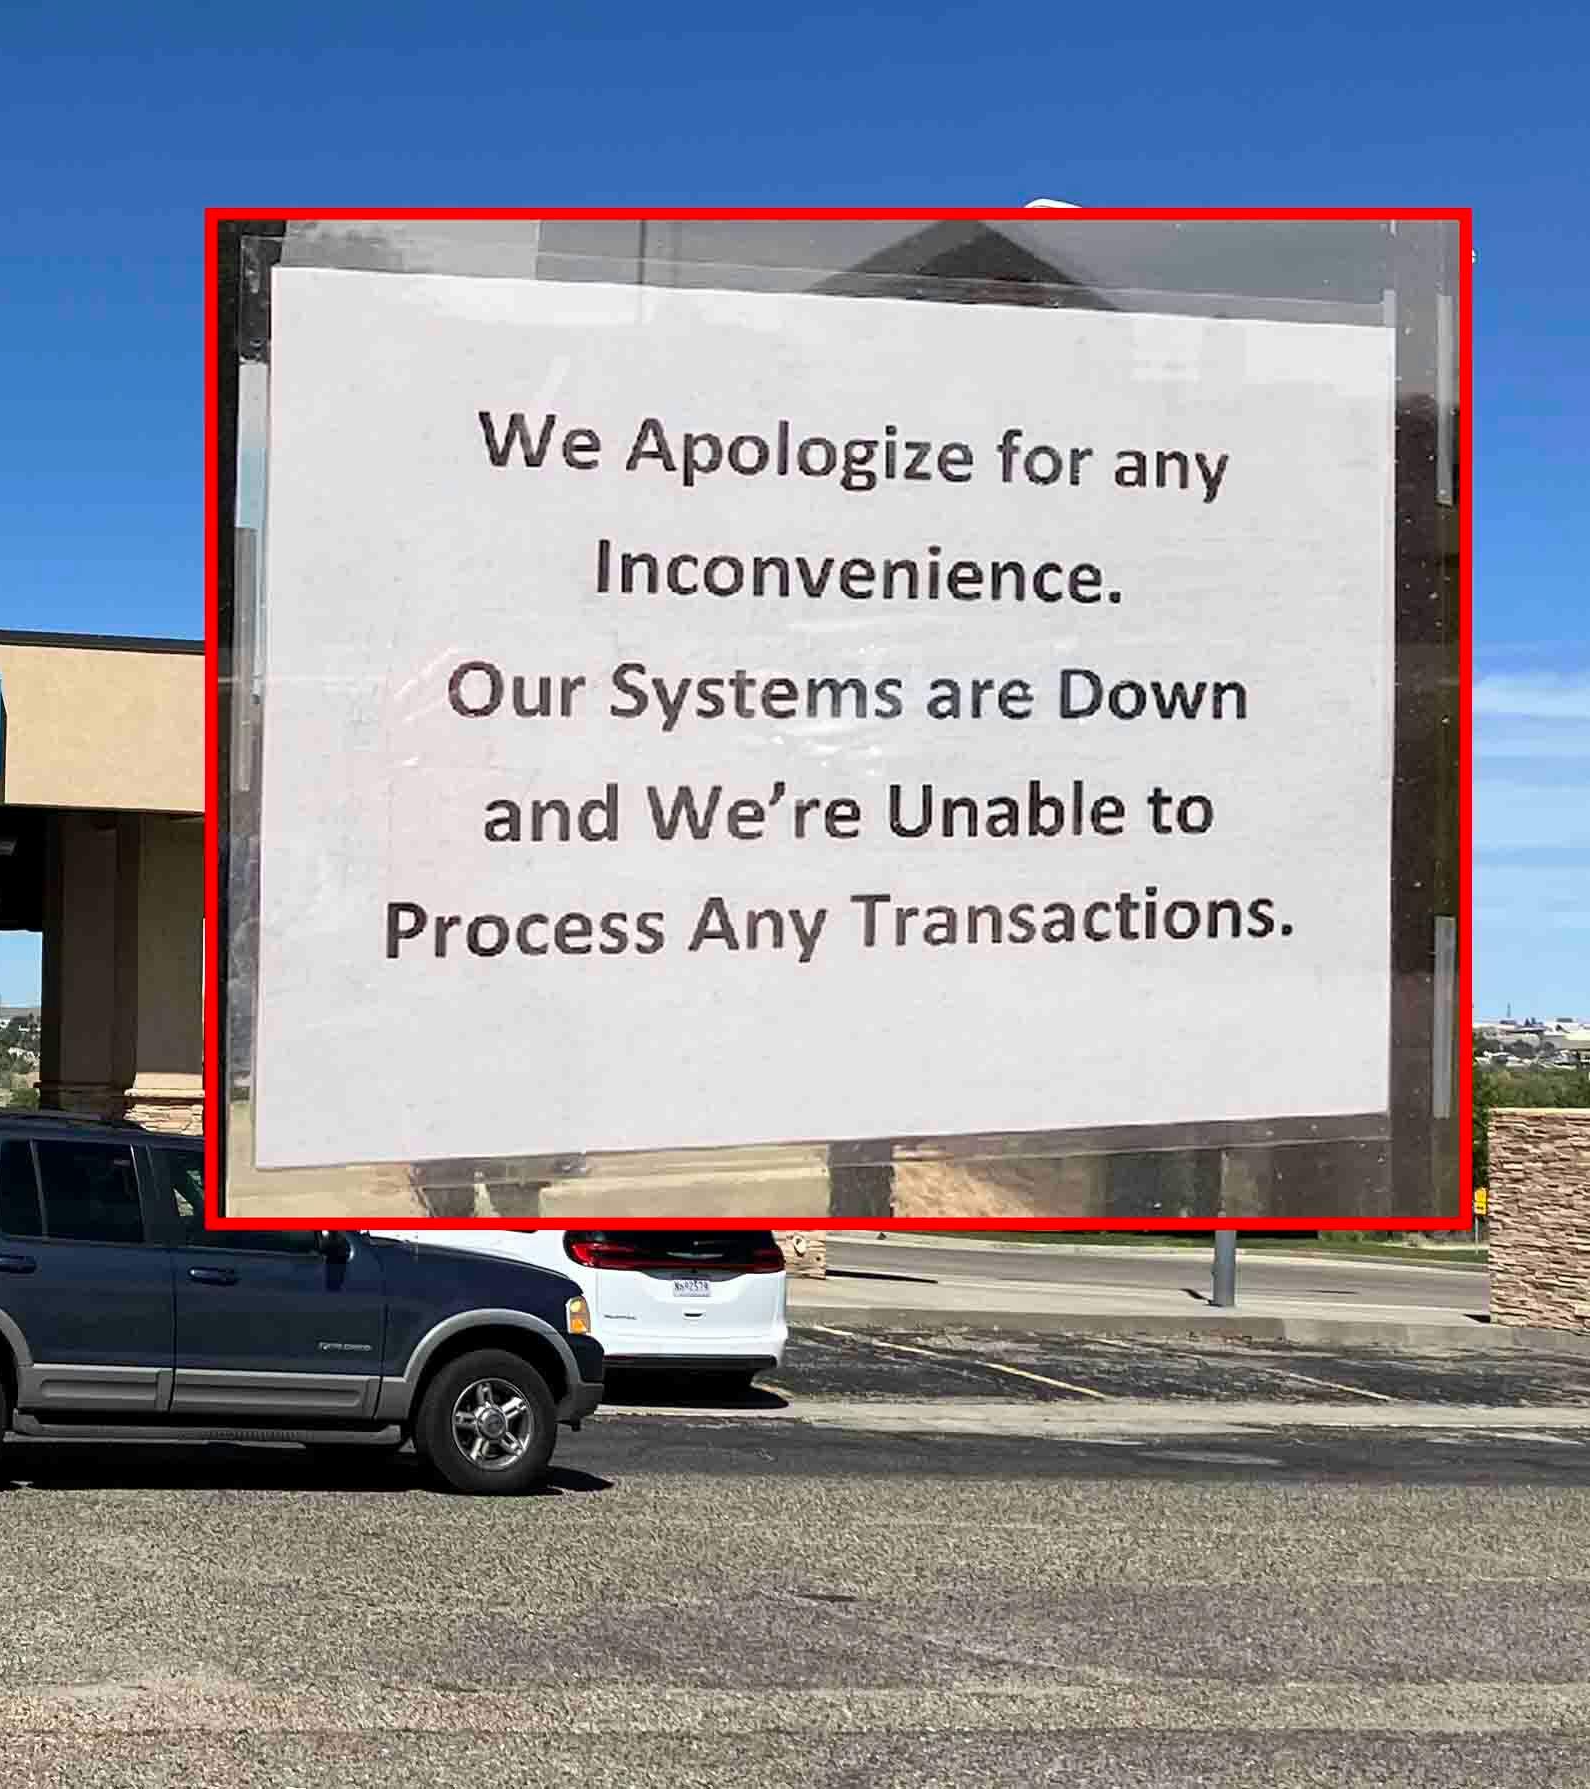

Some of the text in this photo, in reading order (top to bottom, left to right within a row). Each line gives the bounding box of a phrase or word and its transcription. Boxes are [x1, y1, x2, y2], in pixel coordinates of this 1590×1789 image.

[479, 410, 1230, 505] We Apologize for any
[596, 538, 1122, 604] Inconvenience.
[447, 661, 1247, 732] Our Systems are Down
[484, 779, 1214, 843] and We’re Unable to
[386, 885, 1293, 964] Process Any Transactions.
